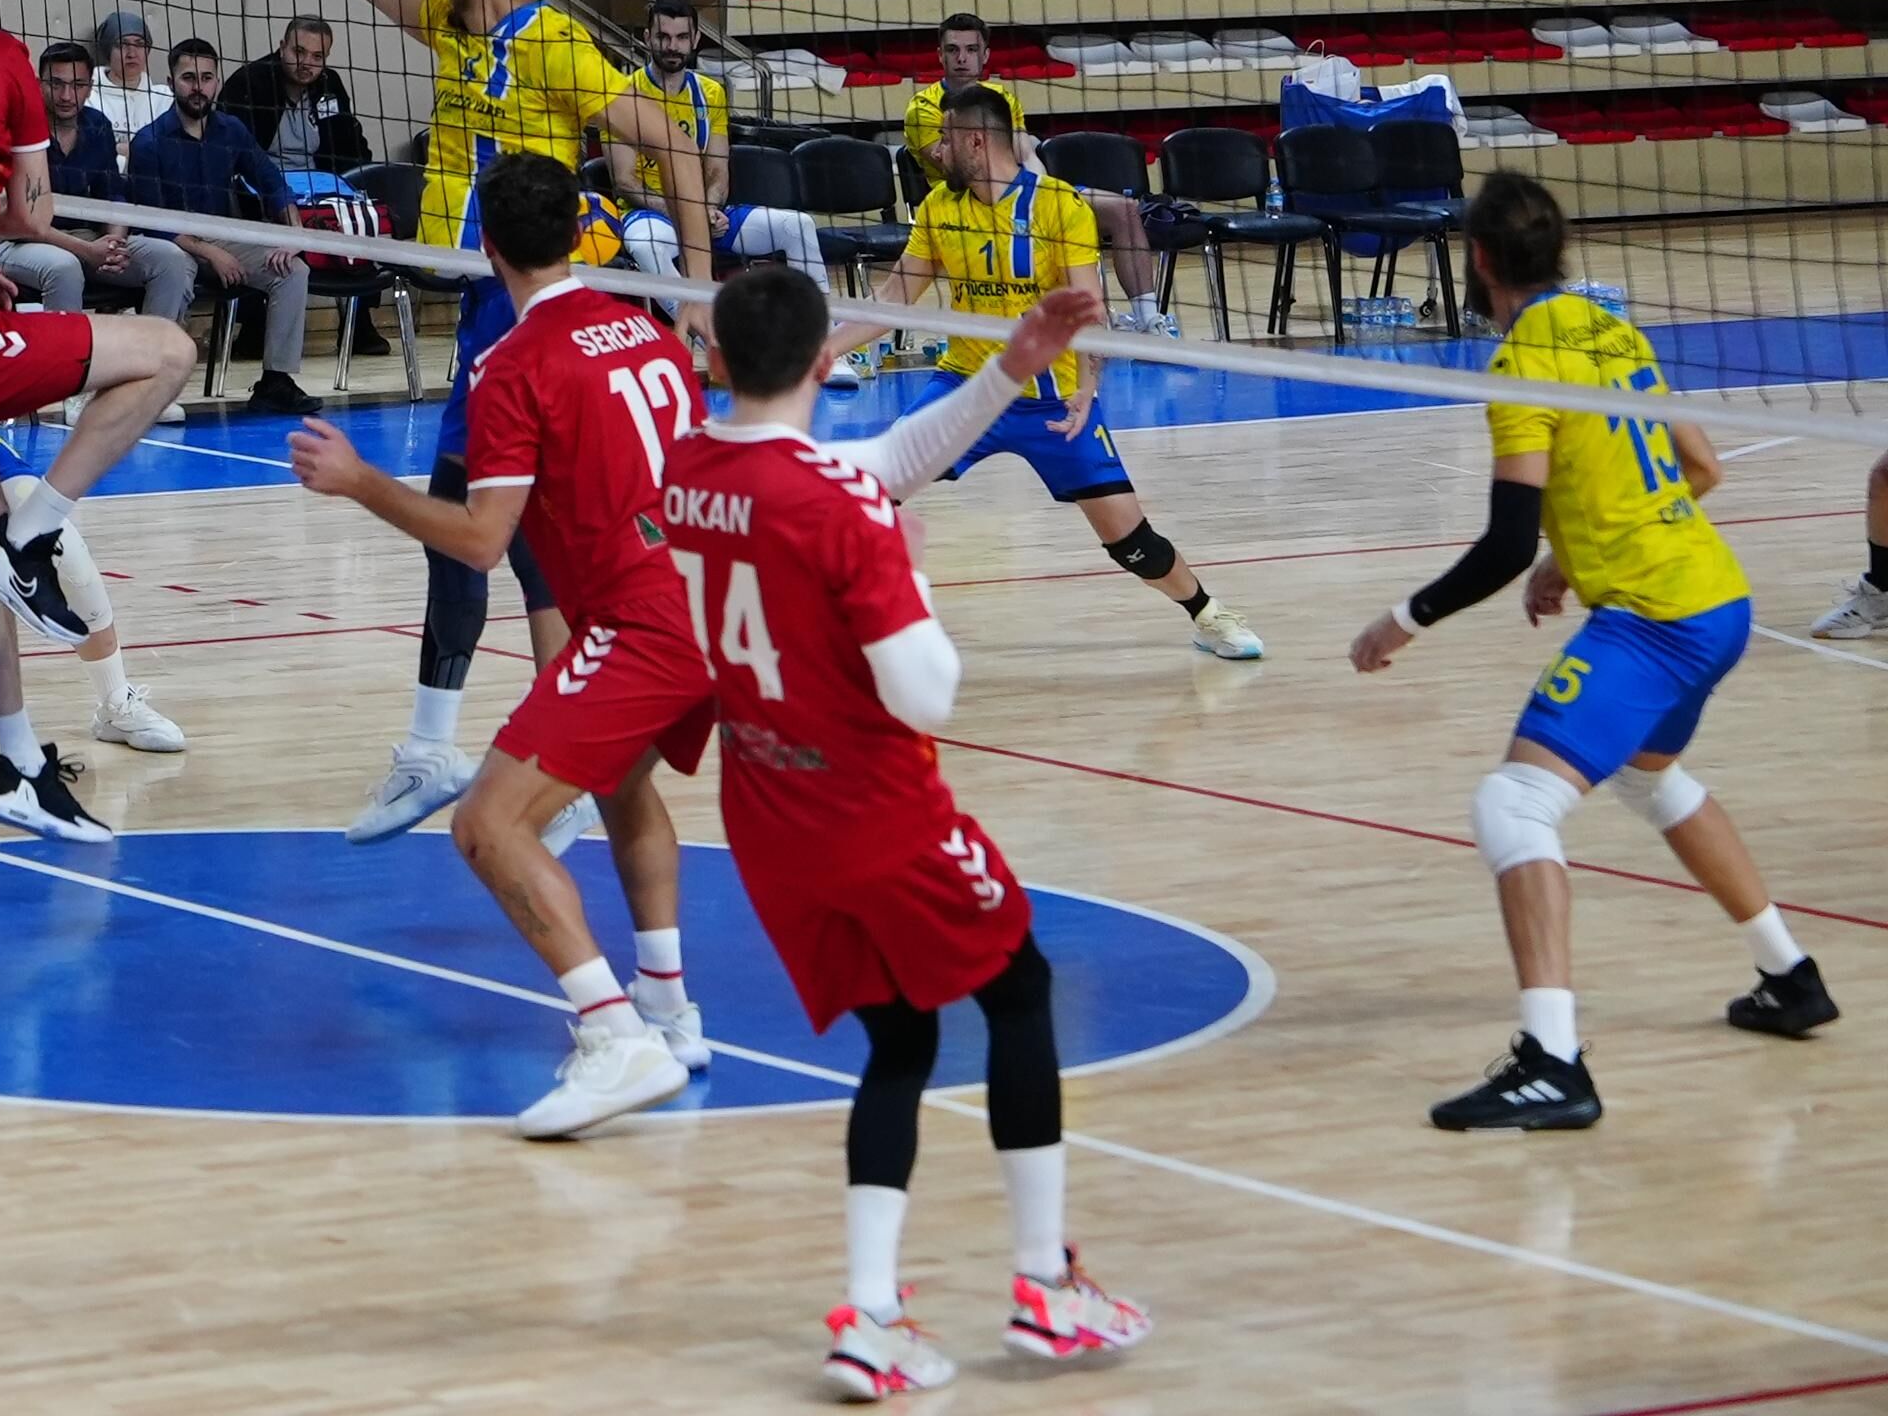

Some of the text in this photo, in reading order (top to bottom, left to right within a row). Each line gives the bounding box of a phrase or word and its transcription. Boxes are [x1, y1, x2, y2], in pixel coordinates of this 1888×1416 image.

[979, 240, 993, 275] 1
[571, 315, 661, 357] SERCAN
[608, 358, 692, 489] 12
[1094, 424, 1114, 458] 1
[1606, 367, 1681, 493] 15
[664, 486, 753, 535] OKAN
[669, 547, 785, 701] 14
